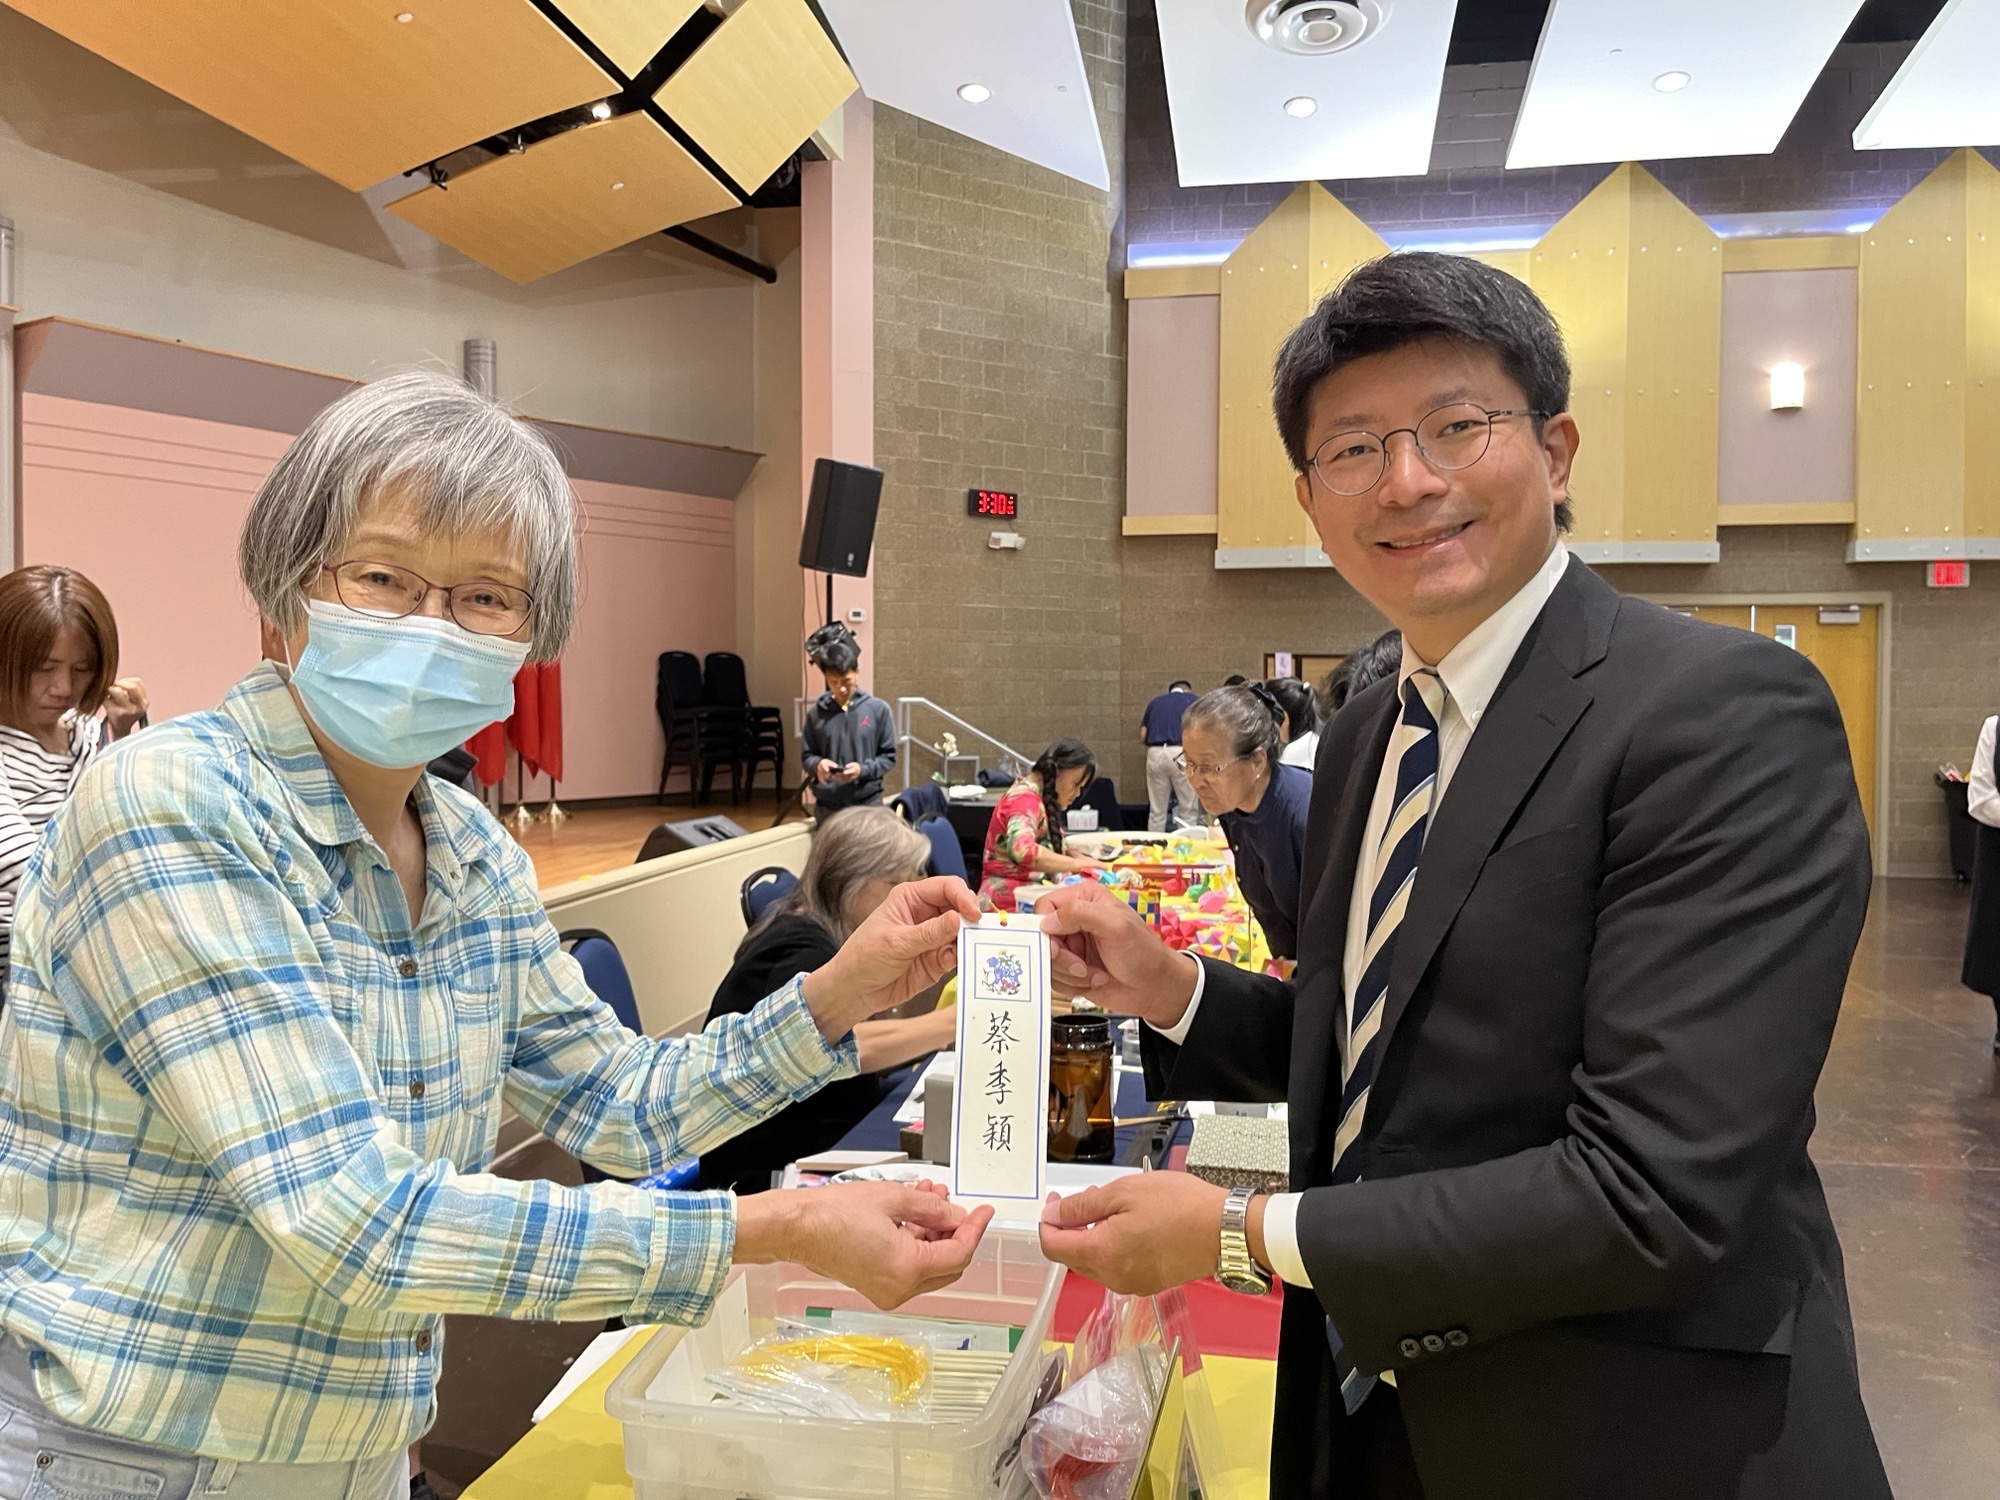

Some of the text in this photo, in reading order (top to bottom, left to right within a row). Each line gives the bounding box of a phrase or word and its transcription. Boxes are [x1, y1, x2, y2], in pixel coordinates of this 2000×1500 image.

[978, 492, 1007, 515] 3:30
[982, 1010, 1020, 1152] 蔡季穎
